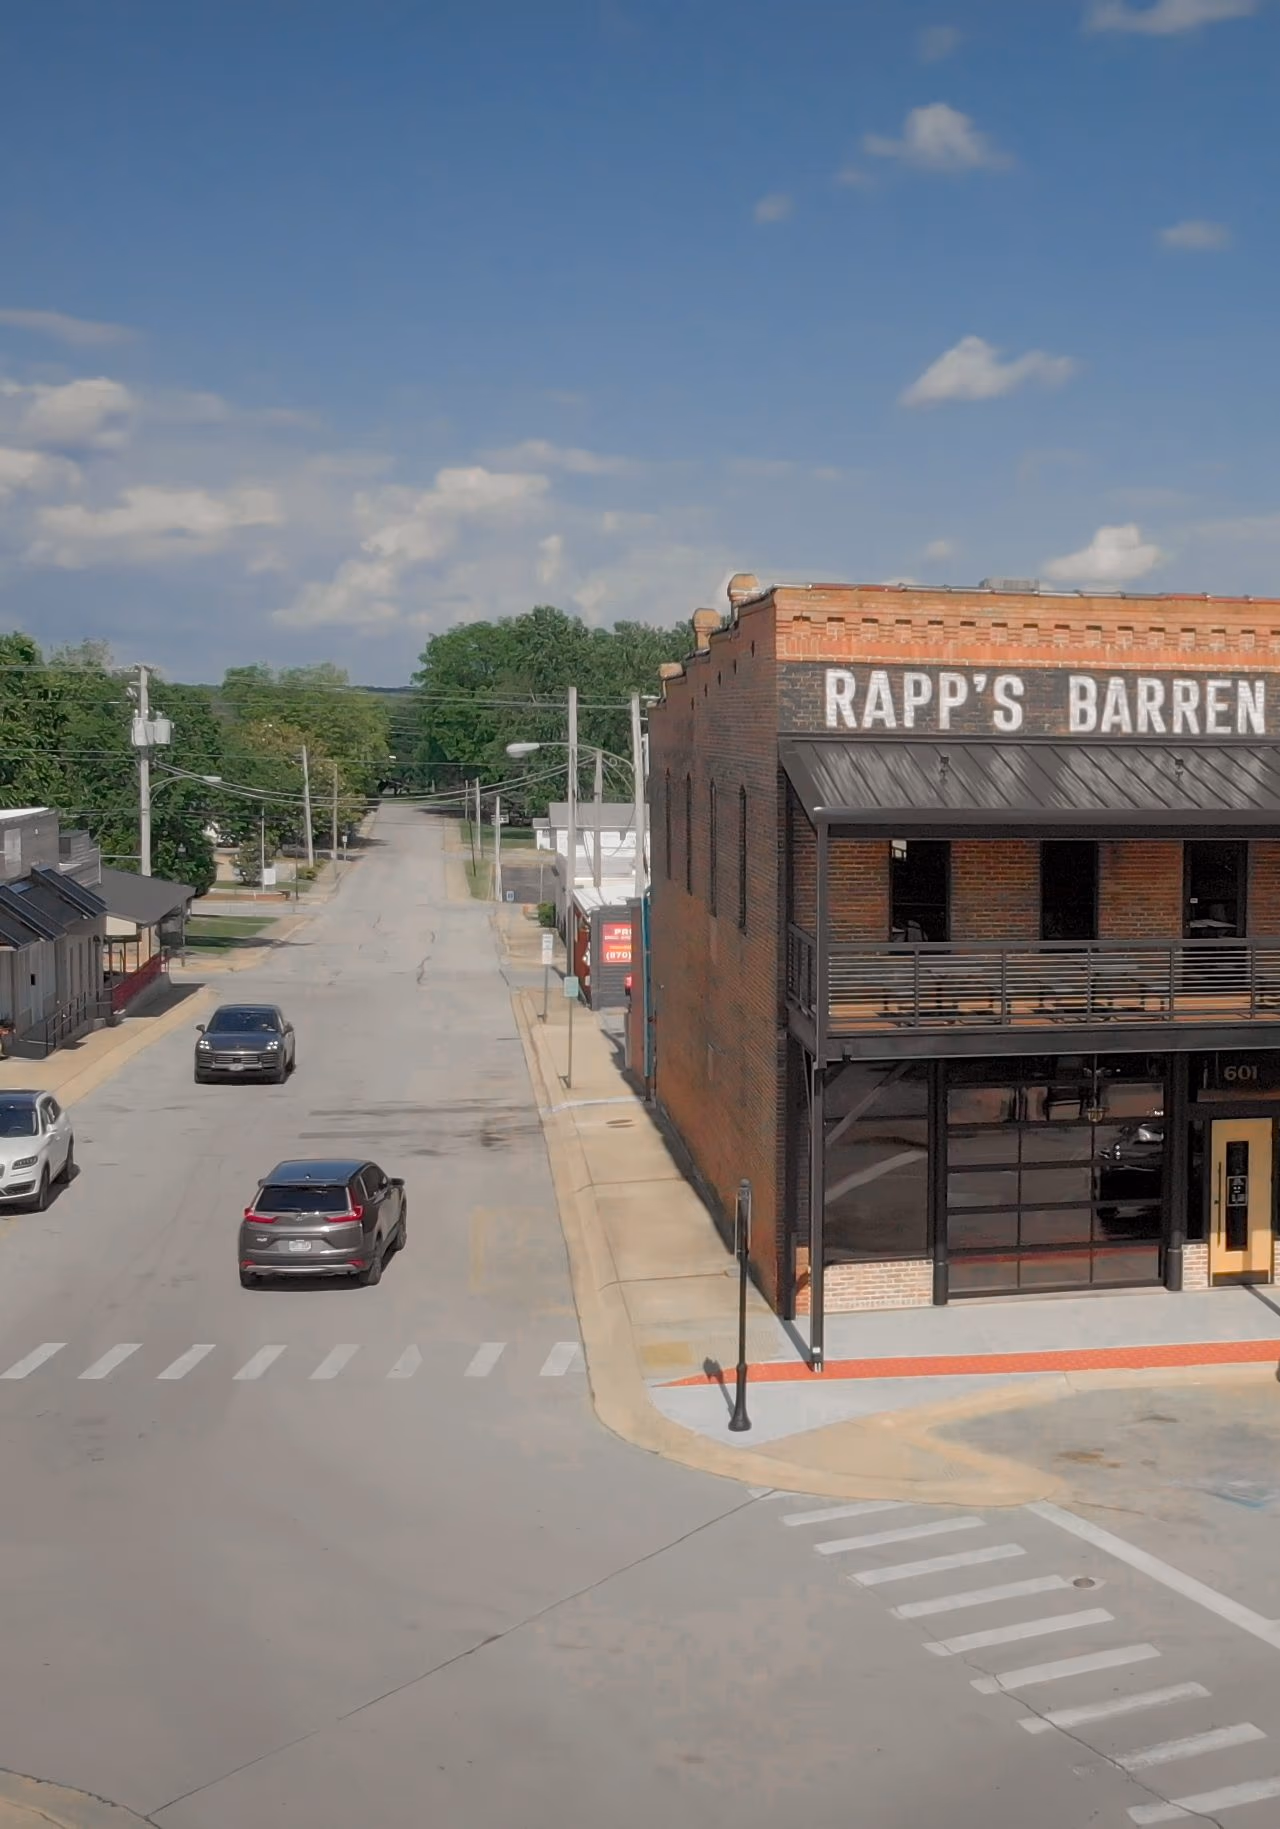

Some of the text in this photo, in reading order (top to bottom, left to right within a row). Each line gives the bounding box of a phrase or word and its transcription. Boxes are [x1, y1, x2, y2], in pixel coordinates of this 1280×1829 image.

[825, 668, 1025, 732] RAPP'S
[1068, 674, 1266, 735] BARREN
[1224, 1065, 1258, 1081] 601
